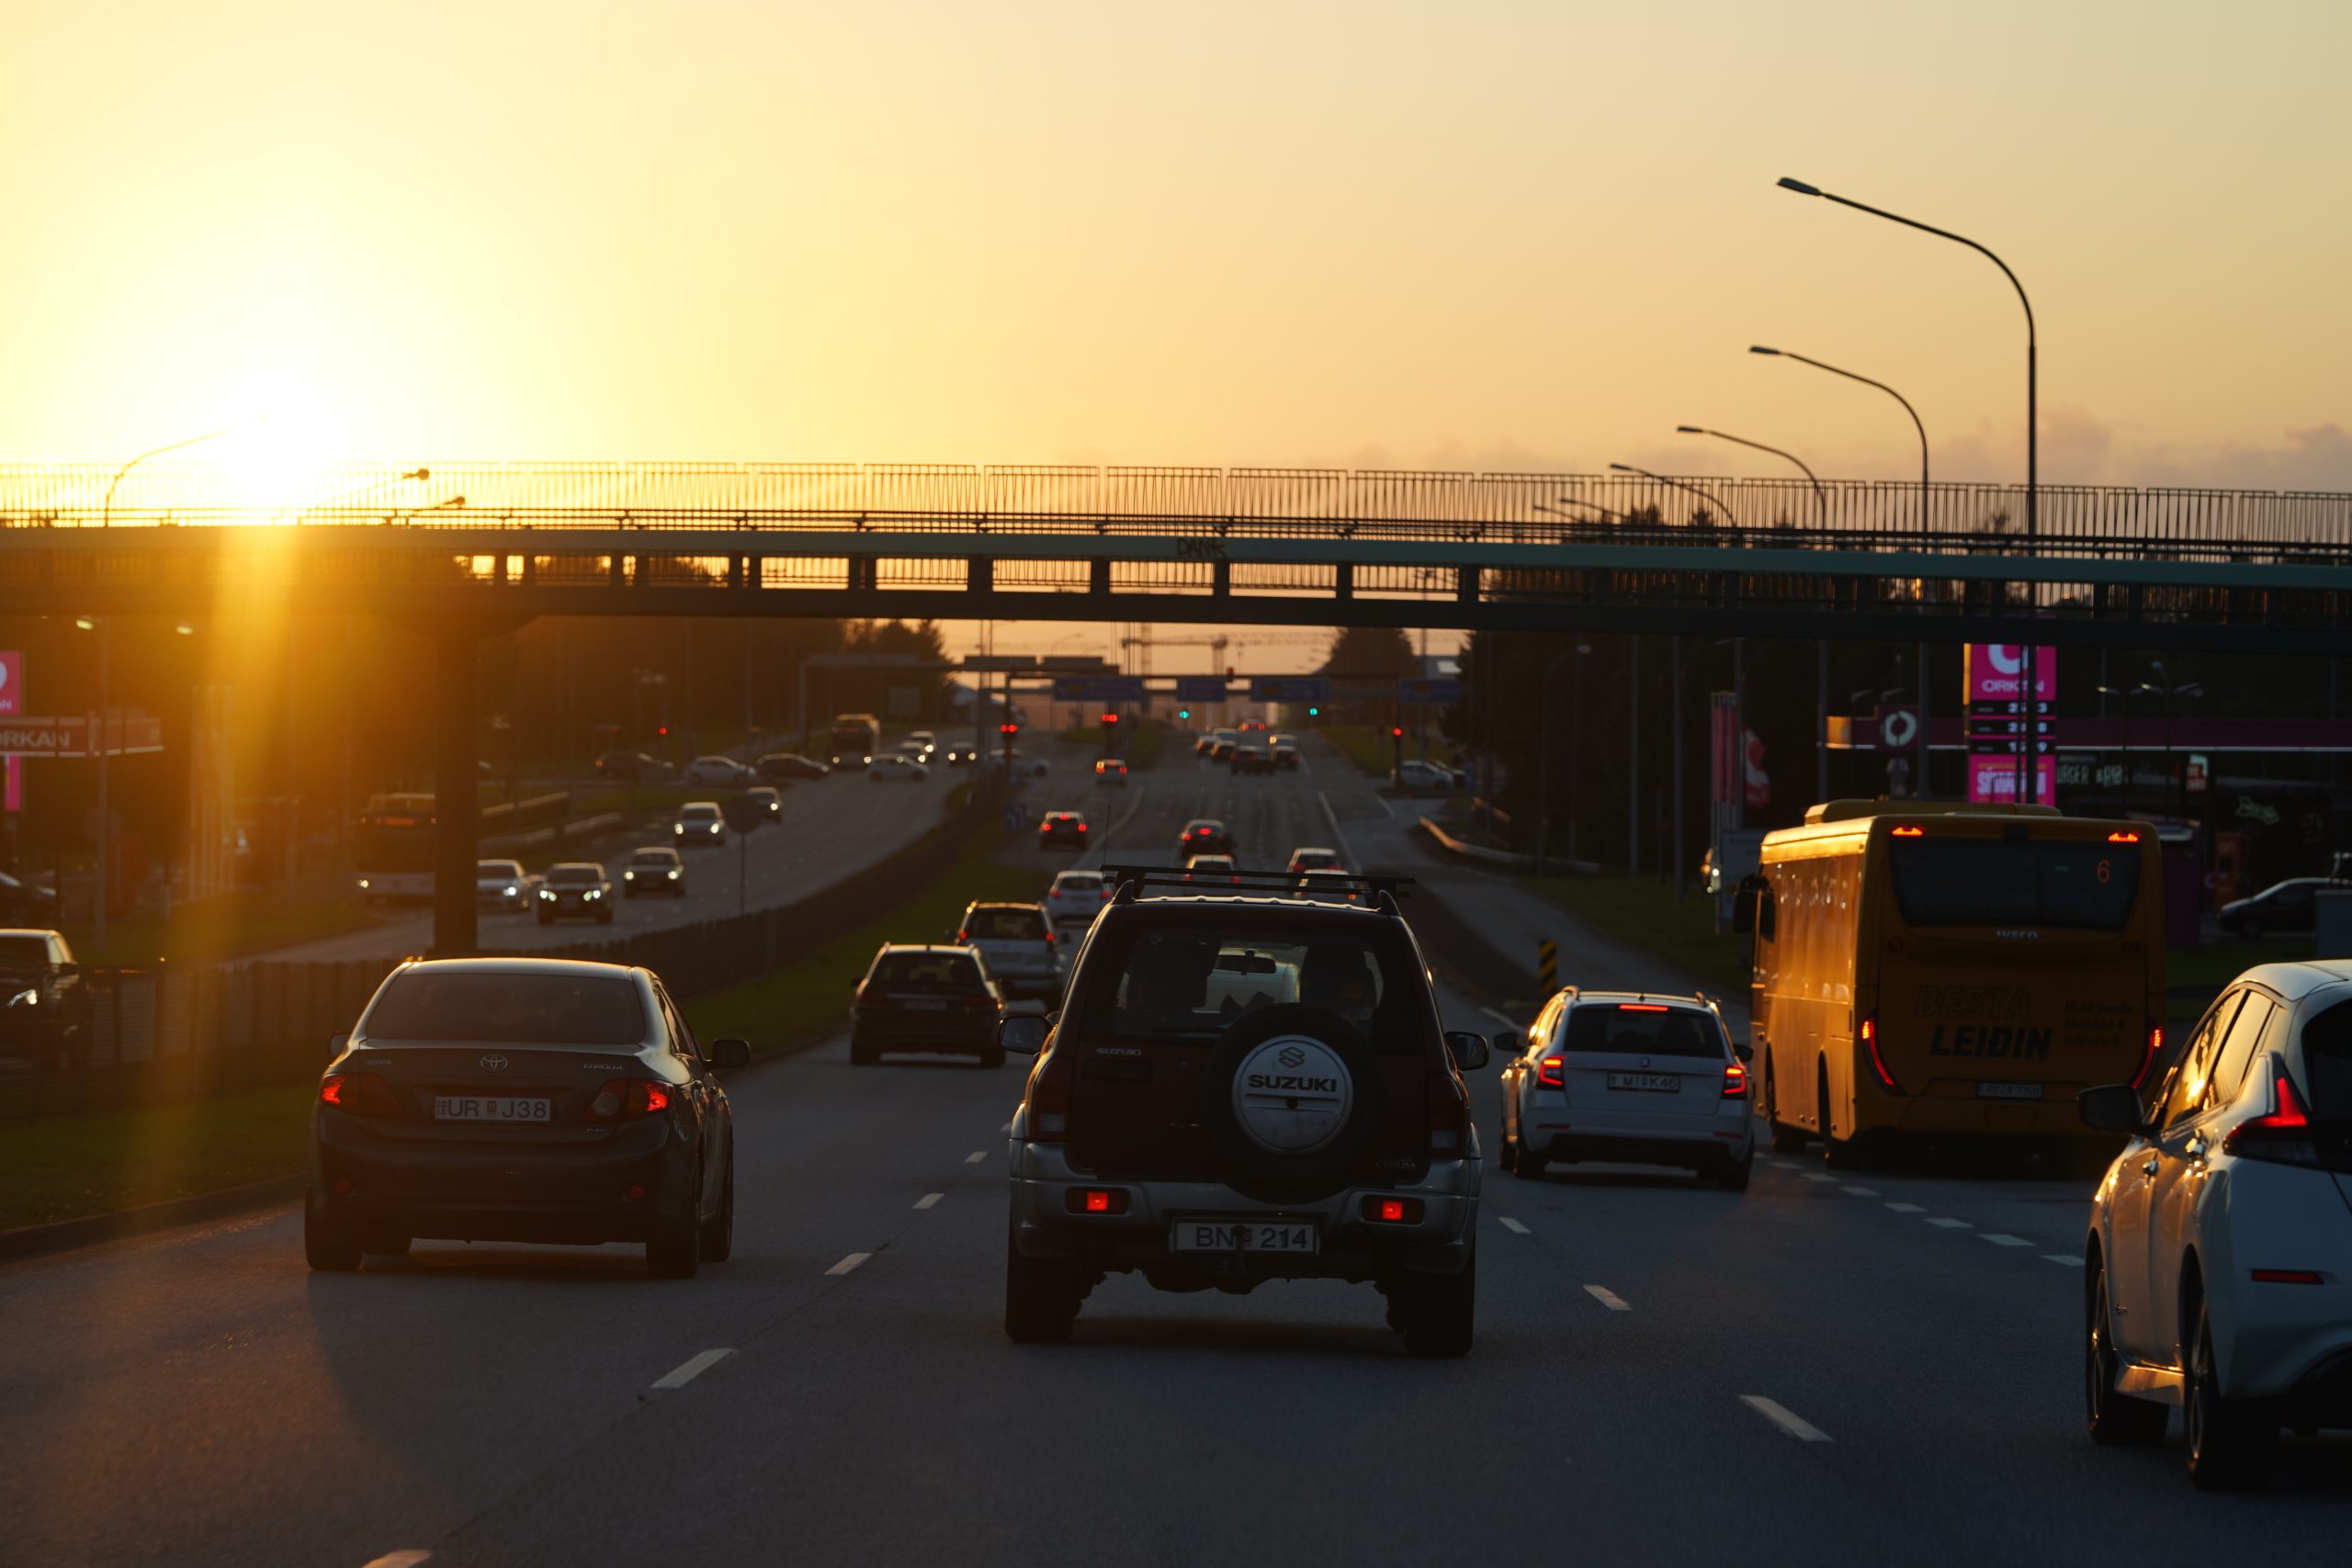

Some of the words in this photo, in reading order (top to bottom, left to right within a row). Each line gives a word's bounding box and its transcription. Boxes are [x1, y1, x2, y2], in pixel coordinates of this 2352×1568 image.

[0, 729, 71, 750] RKAN
[2096, 860, 2111, 884] 6
[1996, 928, 2039, 939] IVECO
[1913, 985, 2030, 1021] BESTA
[1096, 1047, 1142, 1056] SUZUKI
[1931, 1025, 2053, 1059] LEIÐIN
[1248, 1074, 1338, 1093] SUZUKI
[448, 1098, 479, 1118] UR
[502, 1100, 547, 1119] J38
[1196, 1226, 1234, 1247] BN
[1260, 1227, 1307, 1249] 214
